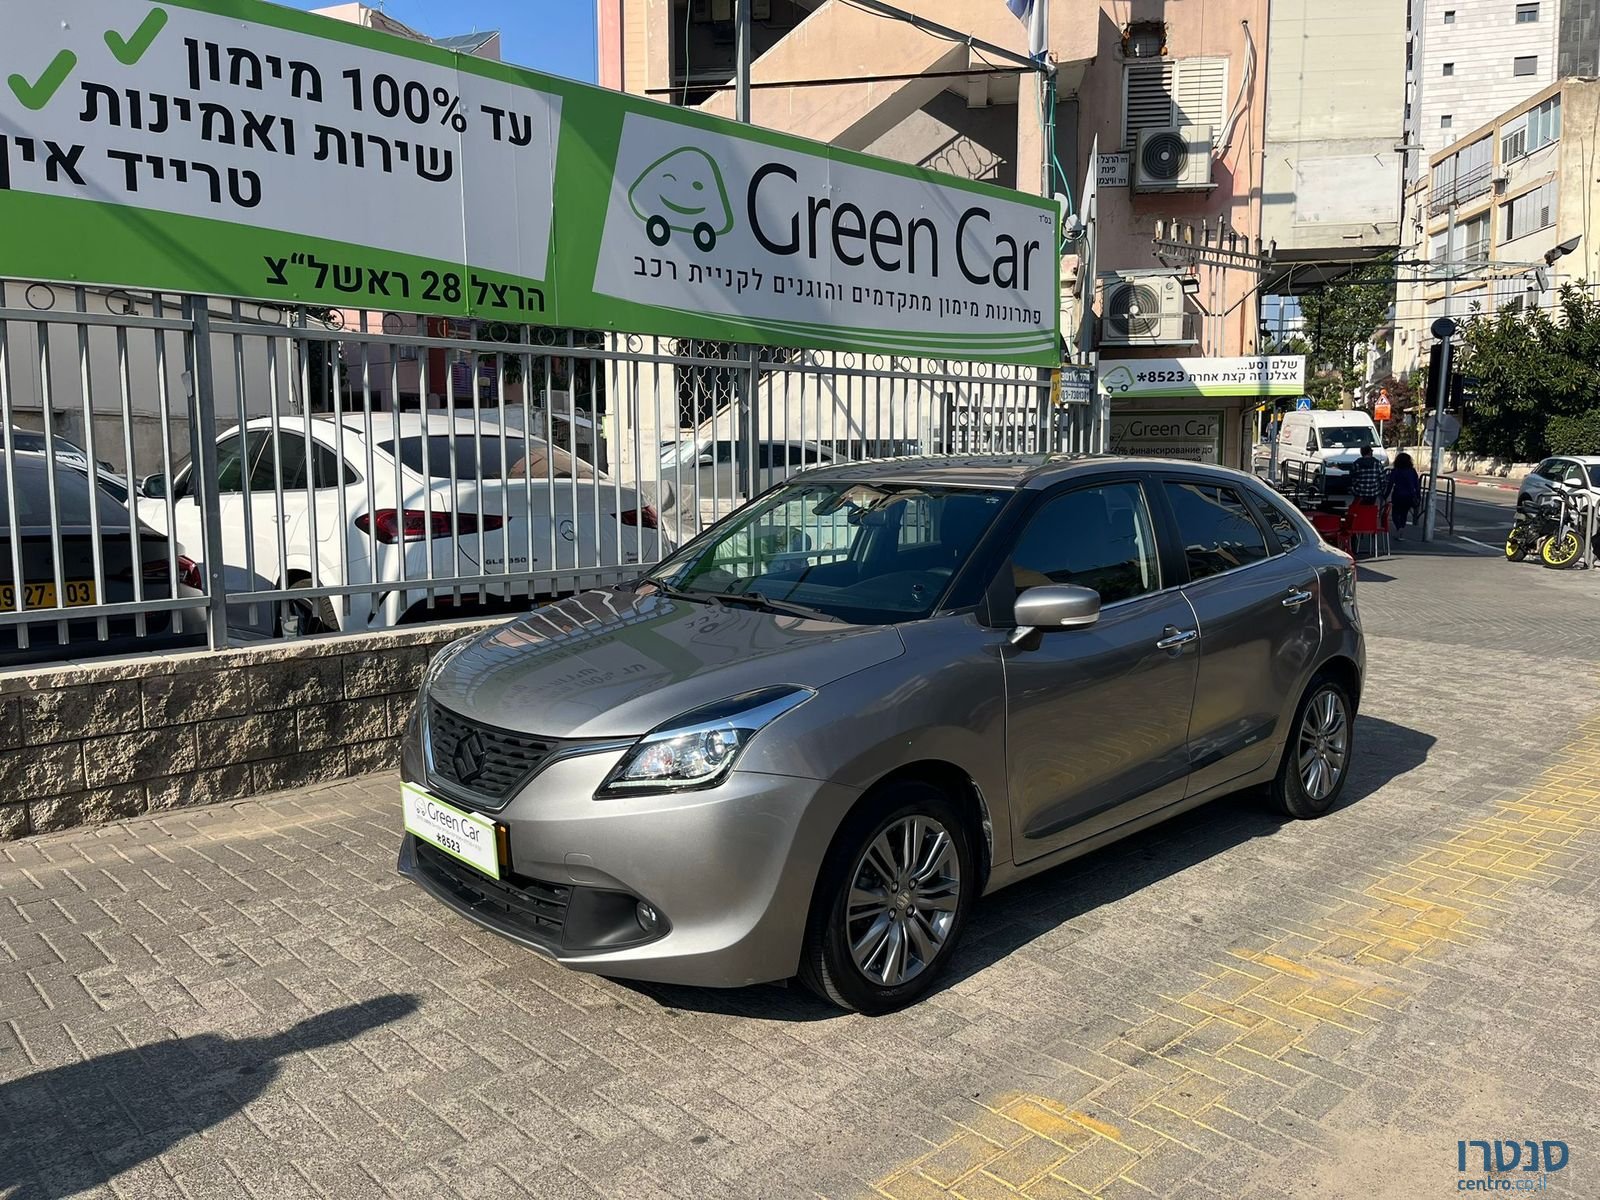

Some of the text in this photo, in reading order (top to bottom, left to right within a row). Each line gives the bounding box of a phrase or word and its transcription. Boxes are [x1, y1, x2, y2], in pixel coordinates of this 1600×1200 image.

[183, 37, 533, 147] עד 100% מימון
[79, 81, 455, 183] שירות ואמינות
[1100, 166, 1116, 174] פינת
[1101, 155, 1119, 164] הרצל
[107, 148, 262, 208] טרייד
[747, 162, 1040, 291] Green Car
[420, 270, 462, 303] 28
[470, 274, 545, 312] הרצל
[634, 255, 1043, 325] פתרונות מימון מתקדמים והוגנים לקניית רכב
[1188, 371, 1297, 383] אצלנו זה קצת אחרת
[1272, 360, 1298, 370] שלם
[1130, 420, 1214, 437] Green Car
[1129, 446, 1201, 456] финансирование
[1202, 447, 1213, 455] до
[427, 802, 480, 842] Green Car
